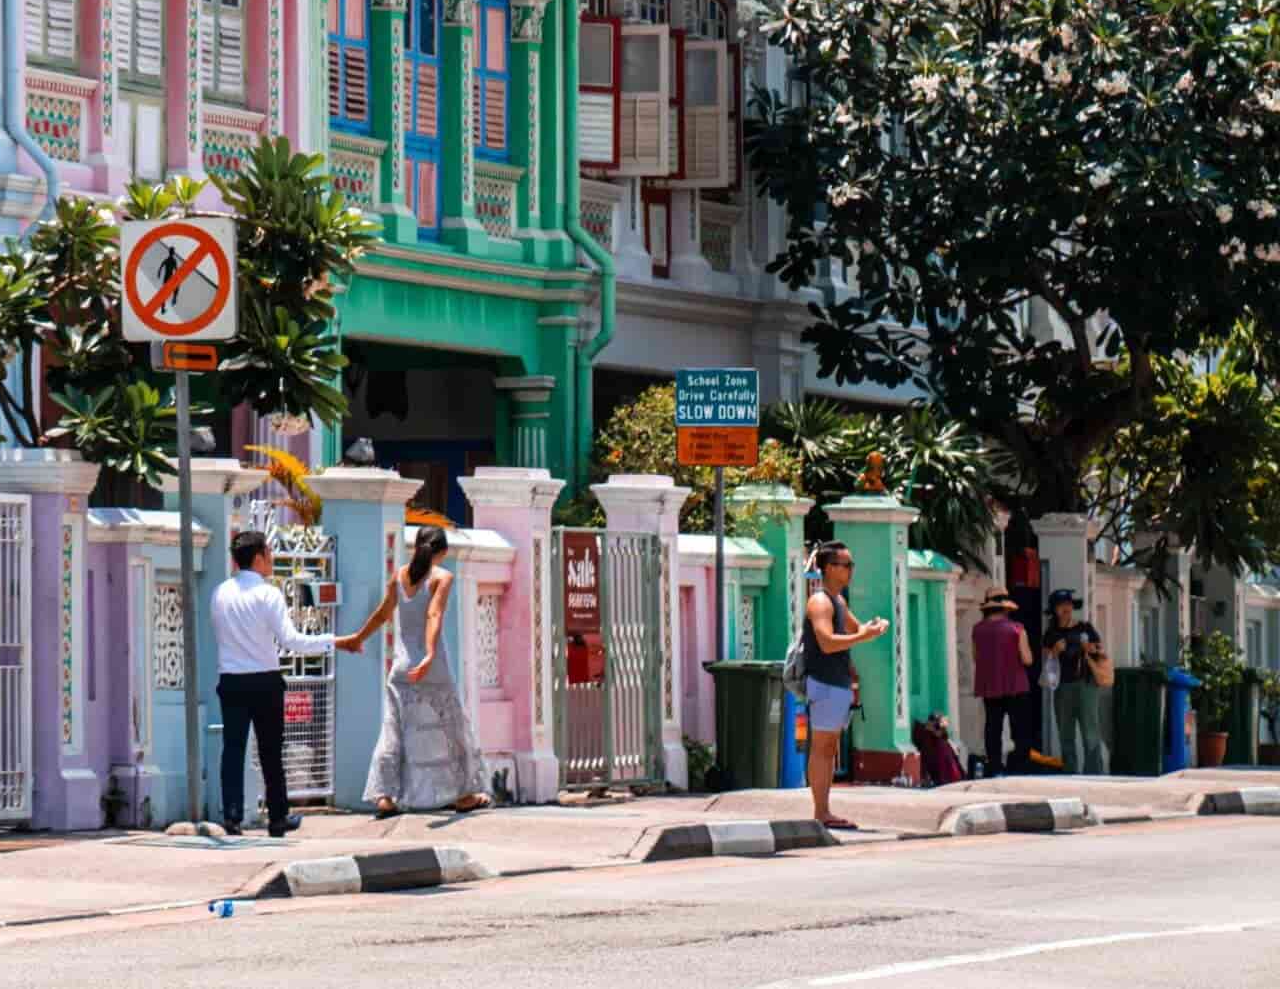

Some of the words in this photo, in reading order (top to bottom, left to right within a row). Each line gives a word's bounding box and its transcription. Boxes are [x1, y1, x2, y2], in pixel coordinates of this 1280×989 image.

[687, 374, 720, 387] School
[724, 374, 748, 387] Zone
[679, 389, 705, 401] Drive
[710, 389, 756, 404] Carefully
[678, 404, 714, 420] SLOW
[718, 404, 757, 420] DOWN
